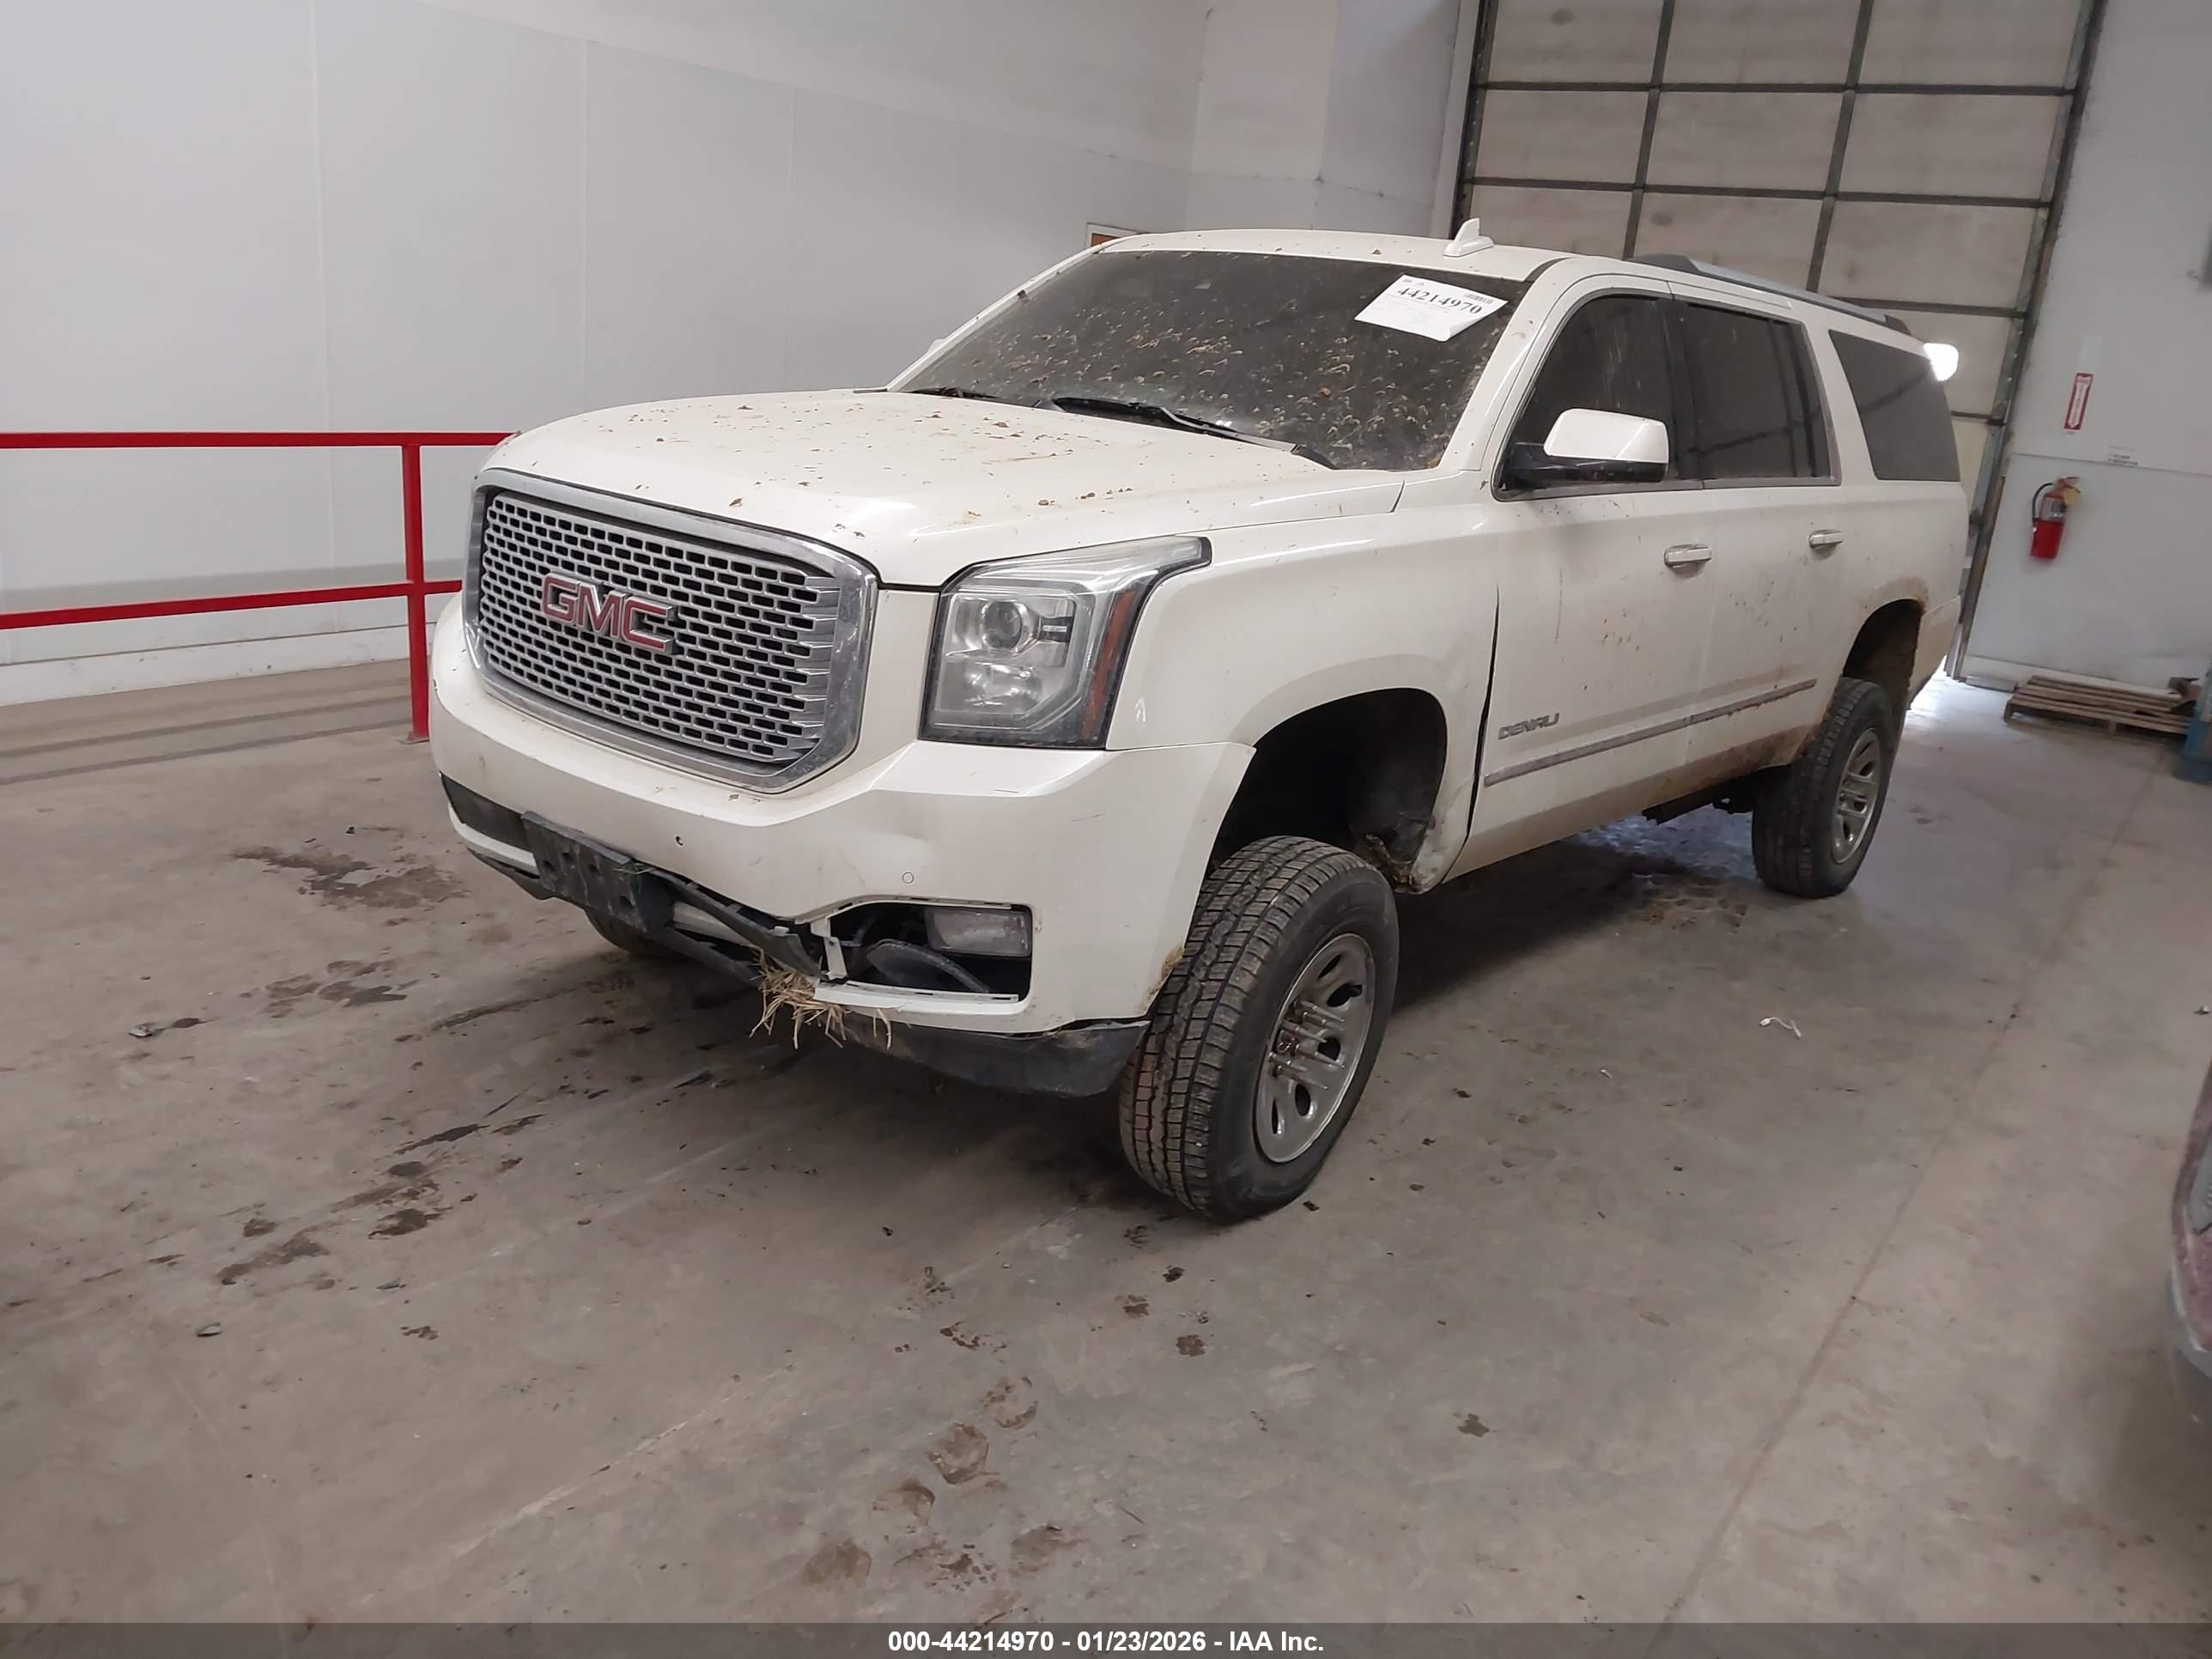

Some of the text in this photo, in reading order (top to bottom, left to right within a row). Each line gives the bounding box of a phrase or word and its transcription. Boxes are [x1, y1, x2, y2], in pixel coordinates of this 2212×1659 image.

[1396, 287, 1483, 314] 44214970
[542, 573, 674, 653] GMC
[1498, 713, 1560, 740] DENALI
